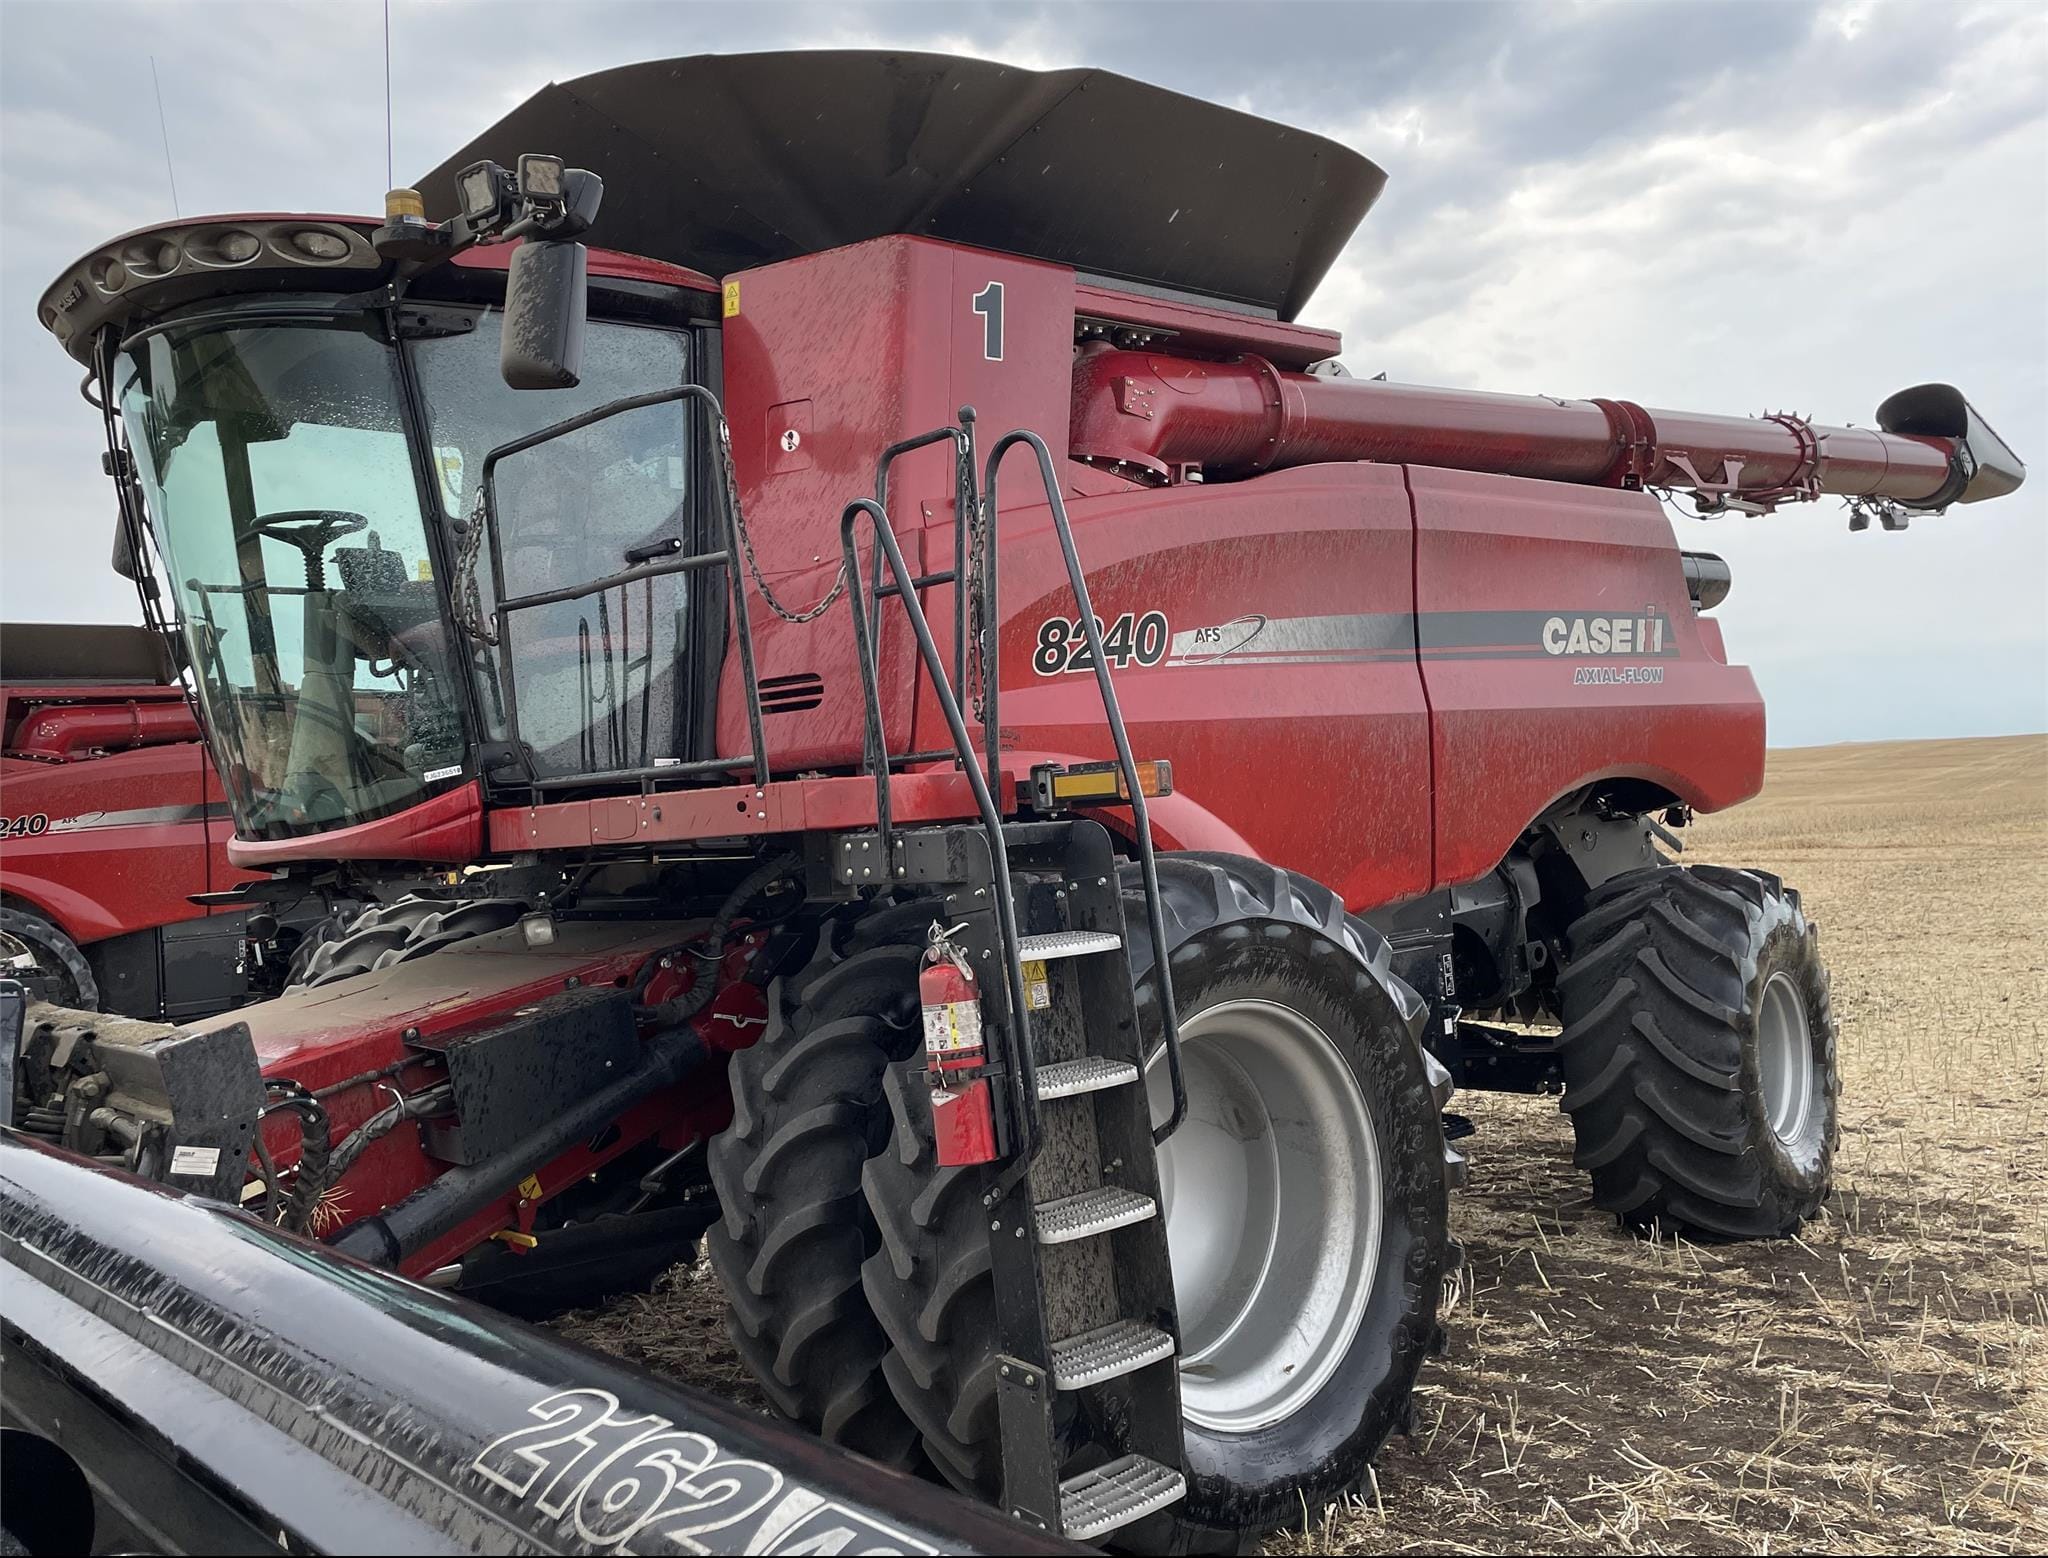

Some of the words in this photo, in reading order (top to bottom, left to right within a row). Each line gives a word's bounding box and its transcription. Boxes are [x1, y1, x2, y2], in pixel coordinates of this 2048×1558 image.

[973, 281, 1004, 361] 1
[1032, 610, 1168, 676] 8240
[1195, 627, 1221, 643] AFS
[1542, 616, 1633, 655] CASE
[1574, 666, 1664, 684] AXIAL-FLOW
[61, 817, 78, 825] AFS
[472, 1387, 784, 1556] 2162
